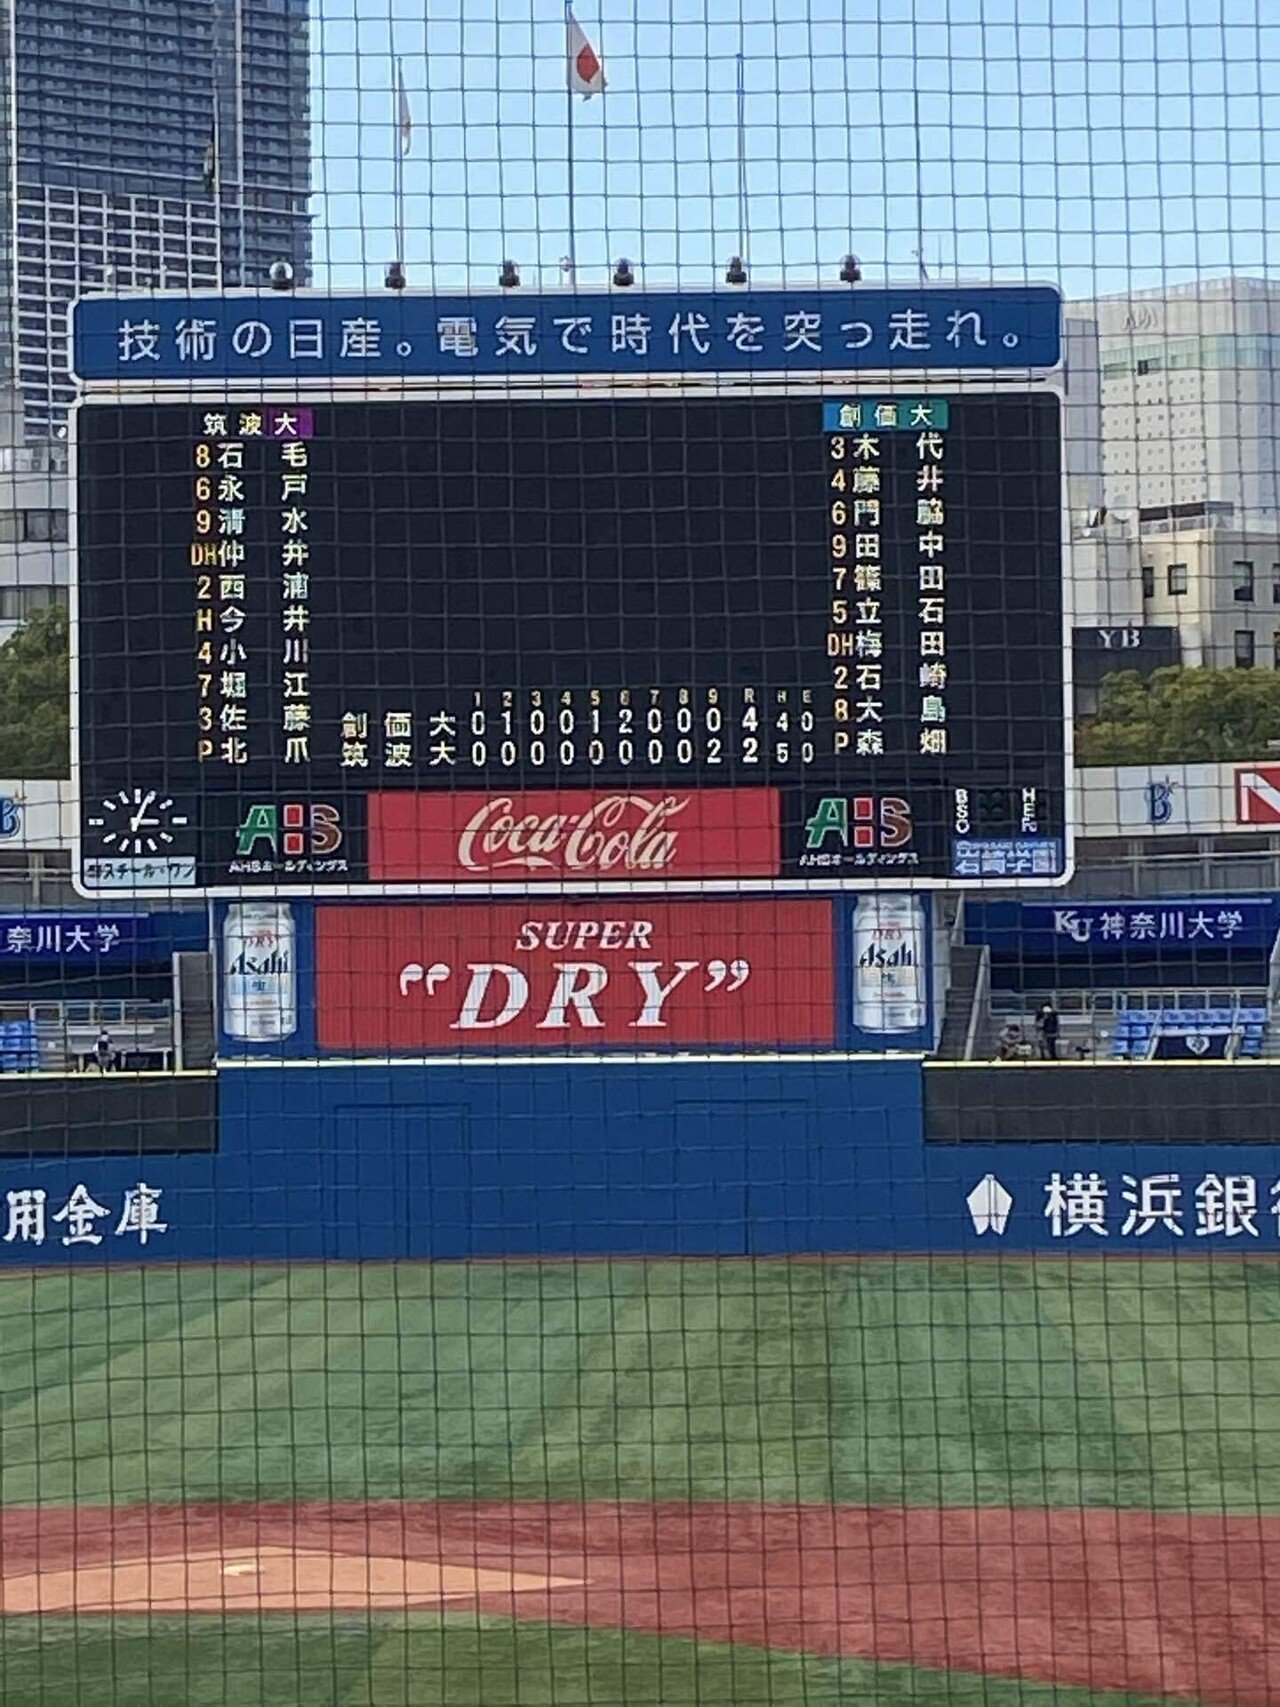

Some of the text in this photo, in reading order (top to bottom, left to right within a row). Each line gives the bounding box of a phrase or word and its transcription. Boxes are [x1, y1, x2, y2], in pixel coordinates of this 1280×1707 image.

[117, 308, 1020, 361] 技術の日産。電気で時代を突っ走れ。
[204, 412, 298, 435] 筑波大
[839, 404, 933, 427] 創価大
[196, 441, 308, 468] 8 石毛
[831, 432, 943, 460] 3 木代
[196, 474, 308, 501] 6 永戸
[831, 468, 846, 492] 4
[196, 507, 308, 535] 9 清水
[832, 501, 846, 525] 6
[191, 539, 309, 567] DH 仲井
[832, 530, 943, 559] 9 田中
[197, 572, 309, 600] 2 西浦
[833, 567, 847, 591] 7
[196, 604, 310, 632] H 今井
[832, 597, 945, 624] 5 立石
[197, 638, 309, 665] 4 小川
[827, 629, 945, 659] DH 梅田
[1099, 629, 1141, 648] YB
[198, 671, 310, 698] 7 堀江
[834, 666, 848, 690] 2
[474, 691, 481, 707] 1
[502, 691, 512, 707] 2
[531, 691, 541, 707] 3
[561, 691, 571, 706] 4
[590, 689, 600, 705] 5
[650, 690, 659, 705] 7
[708, 688, 718, 704] 9
[744, 688, 755, 703] R
[803, 690, 811, 703] E
[834, 695, 946, 723] 8 大島
[200, 703, 311, 731] 3 佐藤
[340, 706, 813, 738] 創価大 0 1 0 0 1 2 0 0 0 4 4 0
[199, 737, 311, 763] P 北爪
[340, 737, 813, 767] 筑波大 0 0 0 0 0 0 0 0 2 2 5 0
[835, 728, 946, 756] P 森畑
[458, 795, 691, 871] Coca-Cola
[0, 924, 120, 953] 奈川大学
[515, 920, 653, 950] SUPER
[1100, 911, 1243, 939] 神奈川大学
[2, 1182, 168, 1245] 用金庫
[1045, 1172, 1280, 1237] 横浜銀
